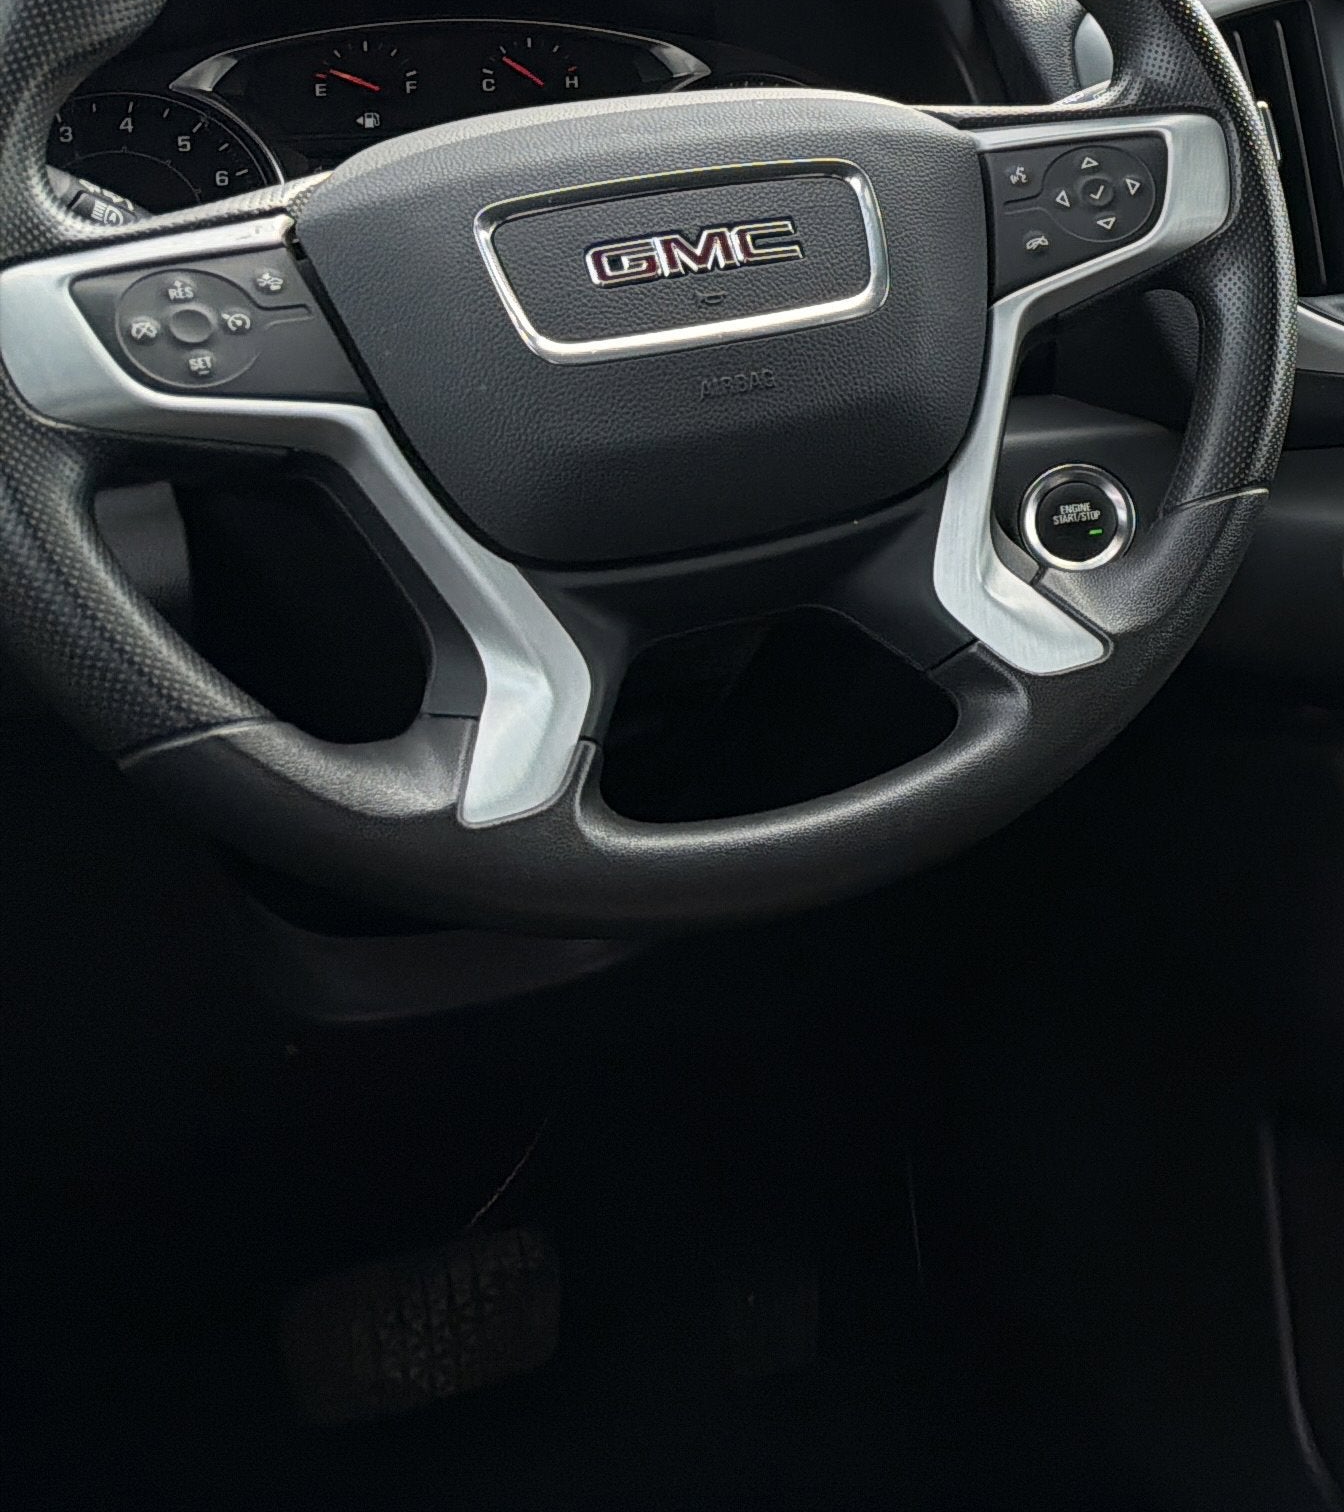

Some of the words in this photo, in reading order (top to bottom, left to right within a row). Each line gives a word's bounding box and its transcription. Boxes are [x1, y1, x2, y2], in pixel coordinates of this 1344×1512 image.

[314, 82, 327, 97] E
[406, 80, 418, 95] F
[482, 76, 496, 92] C
[566, 75, 578, 89] H
[120, 118, 134, 133] 4
[60, 126, 73, 143] 3
[177, 136, 191, 152] 5
[216, 170, 229, 186] 6
[585, 219, 805, 287] GMC
[168, 286, 194, 302] RES
[188, 356, 213, 372] SET
[1060, 502, 1092, 515] ENGINE
[1052, 510, 1100, 526] START/STOP
